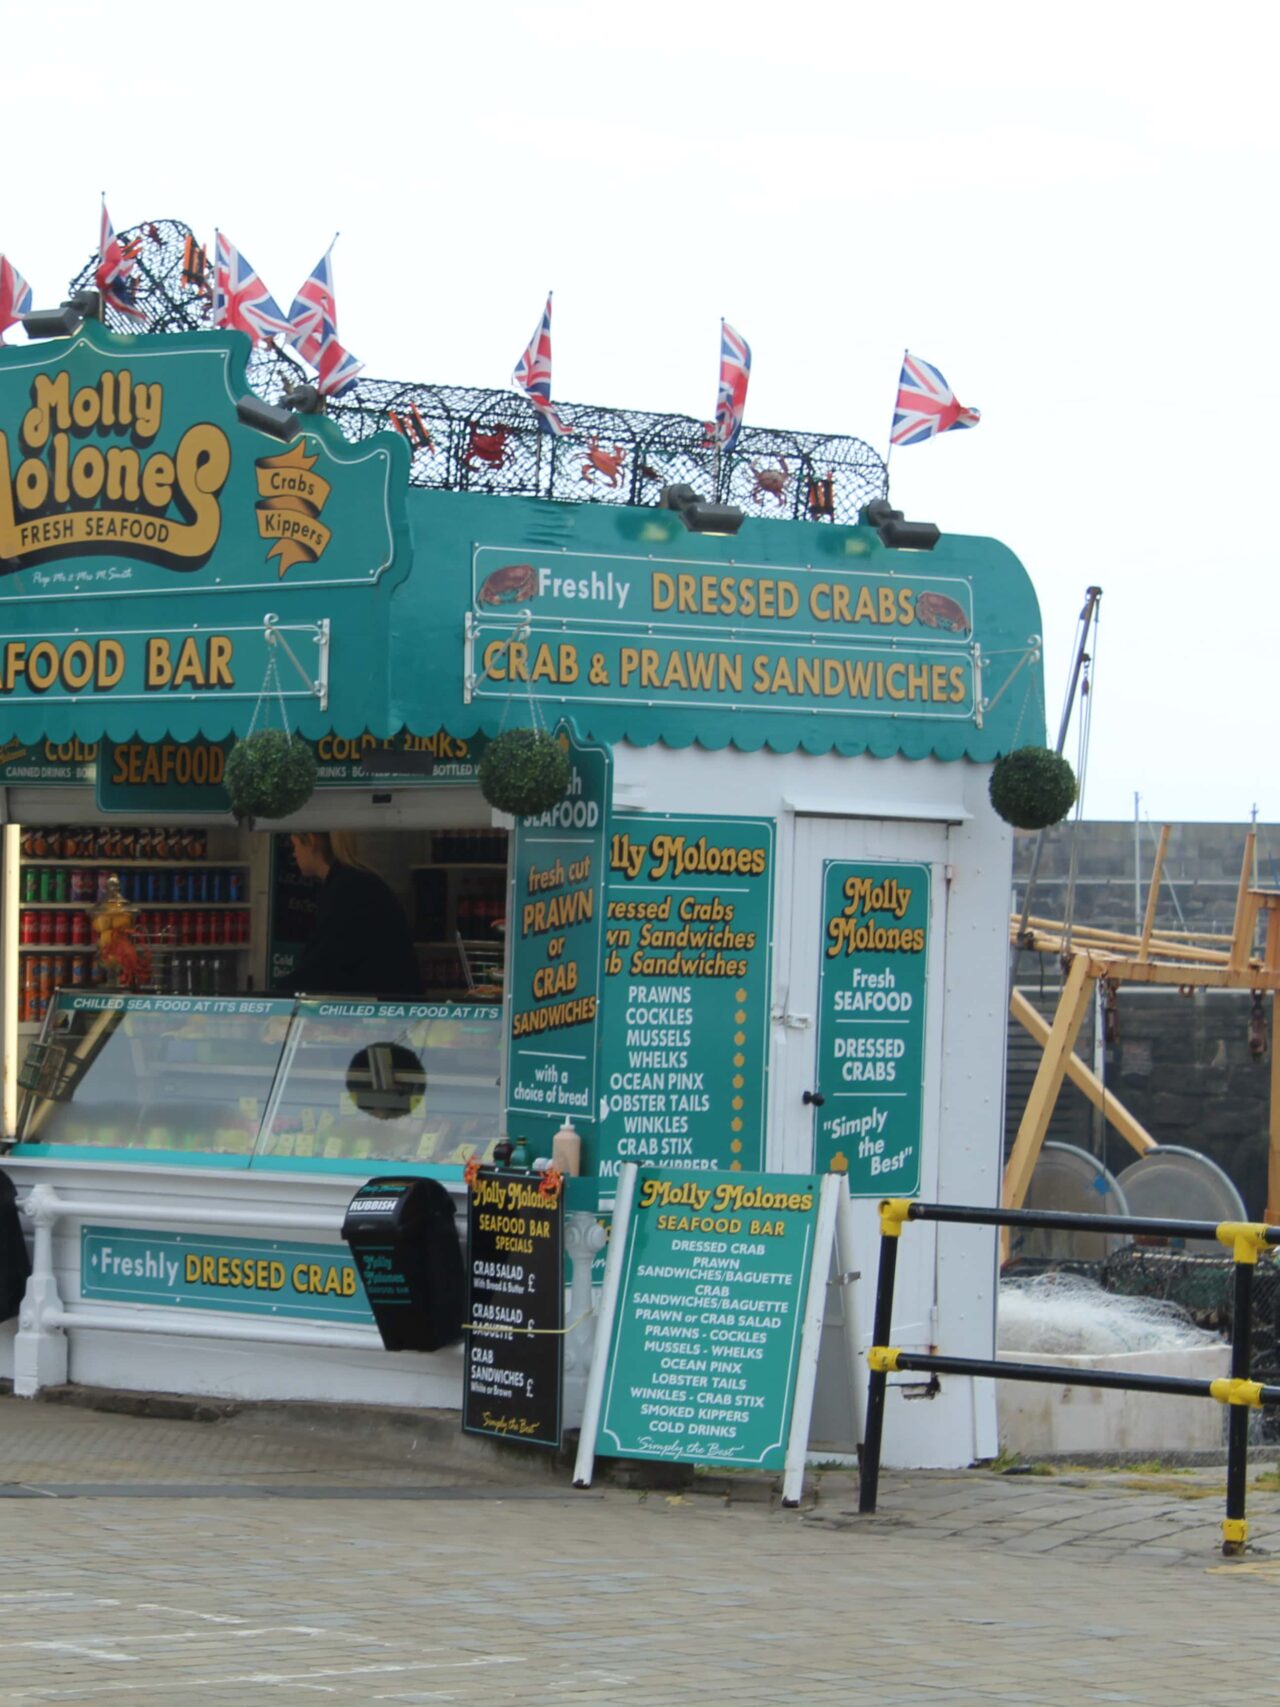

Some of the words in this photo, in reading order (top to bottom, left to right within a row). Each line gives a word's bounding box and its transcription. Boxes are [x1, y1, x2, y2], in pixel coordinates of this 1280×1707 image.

[22, 369, 164, 450] Molly
[270, 471, 316, 496] Crabs
[20, 517, 74, 547] FRESH
[85, 516, 170, 544] SEAFOOD
[265, 513, 324, 546] Kippers
[538, 567, 630, 609] Freshly
[651, 571, 800, 619] DRESSED
[809, 584, 915, 626] CRABS
[146, 634, 235, 692] BAR
[482, 639, 580, 686] CRAB
[589, 651, 611, 687] &
[620, 648, 744, 693] PRAWN
[752, 655, 968, 704] SANDWICHES
[112, 745, 225, 785] SEAFOOD
[432, 764, 473, 777] BOTTLED
[528, 865, 565, 893] fresh
[569, 855, 592, 881] cut
[844, 876, 912, 917] Molly
[522, 888, 594, 938] PRAWN
[607, 896, 671, 919] ressed
[680, 896, 734, 922] Crabs
[548, 936, 565, 957] or
[639, 923, 756, 949] Sandwiches
[631, 950, 748, 977] Sandwiches
[532, 962, 578, 1001] CRAB
[852, 967, 895, 989] Fresh
[628, 985, 691, 1003] PRAWNS
[833, 991, 913, 1013] SEAFOOD
[73, 997, 124, 1010] CHILLED
[126, 998, 152, 1011] SEA
[154, 999, 192, 1012] FOOD
[193, 1000, 210, 1012] AT
[238, 1001, 274, 1014] BEST
[319, 1004, 375, 1017] CHILLED
[378, 1005, 406, 1017] SEA
[409, 1006, 449, 1018] FOOD
[451, 1006, 472, 1018] AT
[513, 996, 597, 1037] SANDWICHES
[625, 1008, 693, 1025] COCKLES
[626, 1029, 691, 1047] MUSSELS
[833, 1038, 905, 1059] DRESSED
[628, 1051, 688, 1069] WHELKS
[535, 1064, 558, 1084] with
[609, 1072, 664, 1091] OCEAN
[667, 1073, 704, 1091] PINX
[841, 1061, 897, 1082] CRABS
[514, 1079, 543, 1102] choice
[545, 1082, 557, 1104] of
[558, 1086, 588, 1108] bread
[670, 1094, 710, 1112] TAILS
[624, 1116, 688, 1134] WINKLES
[617, 1137, 658, 1156] CRAB
[661, 1137, 693, 1156] STIX
[858, 1136, 885, 1159] the
[349, 1200, 398, 1212] RUBBISH
[639, 1179, 711, 1212] Molly
[479, 1213, 525, 1236] SEAFOOD
[529, 1219, 551, 1239] BAR
[656, 1215, 743, 1235] SEAFOOD
[749, 1219, 786, 1237] BAR
[495, 1235, 533, 1254] SPECIALS
[671, 1239, 727, 1253] DRESSED
[730, 1243, 766, 1256] CRAB
[100, 1247, 179, 1286] Freshly
[185, 1253, 286, 1291] DRESSED
[292, 1262, 357, 1297] CRAB
[473, 1260, 495, 1278] CRAB
[496, 1262, 524, 1281] SALAD
[692, 1256, 741, 1270] PRAWN
[636, 1265, 793, 1286] SANDWICHES/BAGUETTE
[694, 1284, 730, 1297] CRAB
[632, 1292, 790, 1314] SANDWICHES/BAGUETTE
[635, 1308, 683, 1322] PRAWN
[684, 1312, 699, 1323] or
[699, 1312, 736, 1326] CRAB
[737, 1315, 782, 1329] SALAD
[644, 1324, 701, 1340] PRAWNS
[709, 1329, 768, 1344] COCKLES
[471, 1347, 494, 1365] CRAB
[643, 1340, 702, 1356] MUSSELS
[711, 1344, 764, 1360] WHELKS
[471, 1364, 525, 1388] SANDWICHES
[660, 1357, 707, 1371] OCEAN
[709, 1360, 743, 1374] PINX
[651, 1372, 708, 1388] LOBSTER
[711, 1377, 747, 1391] TAILS
[630, 1387, 687, 1402] WINKLES
[696, 1391, 732, 1406] CRAB
[734, 1395, 766, 1408] STIX
[639, 1403, 695, 1419] SMOKED
[697, 1408, 750, 1423] KIPPERS
[648, 1420, 685, 1434] COLD
[688, 1423, 737, 1439] DRINKS
